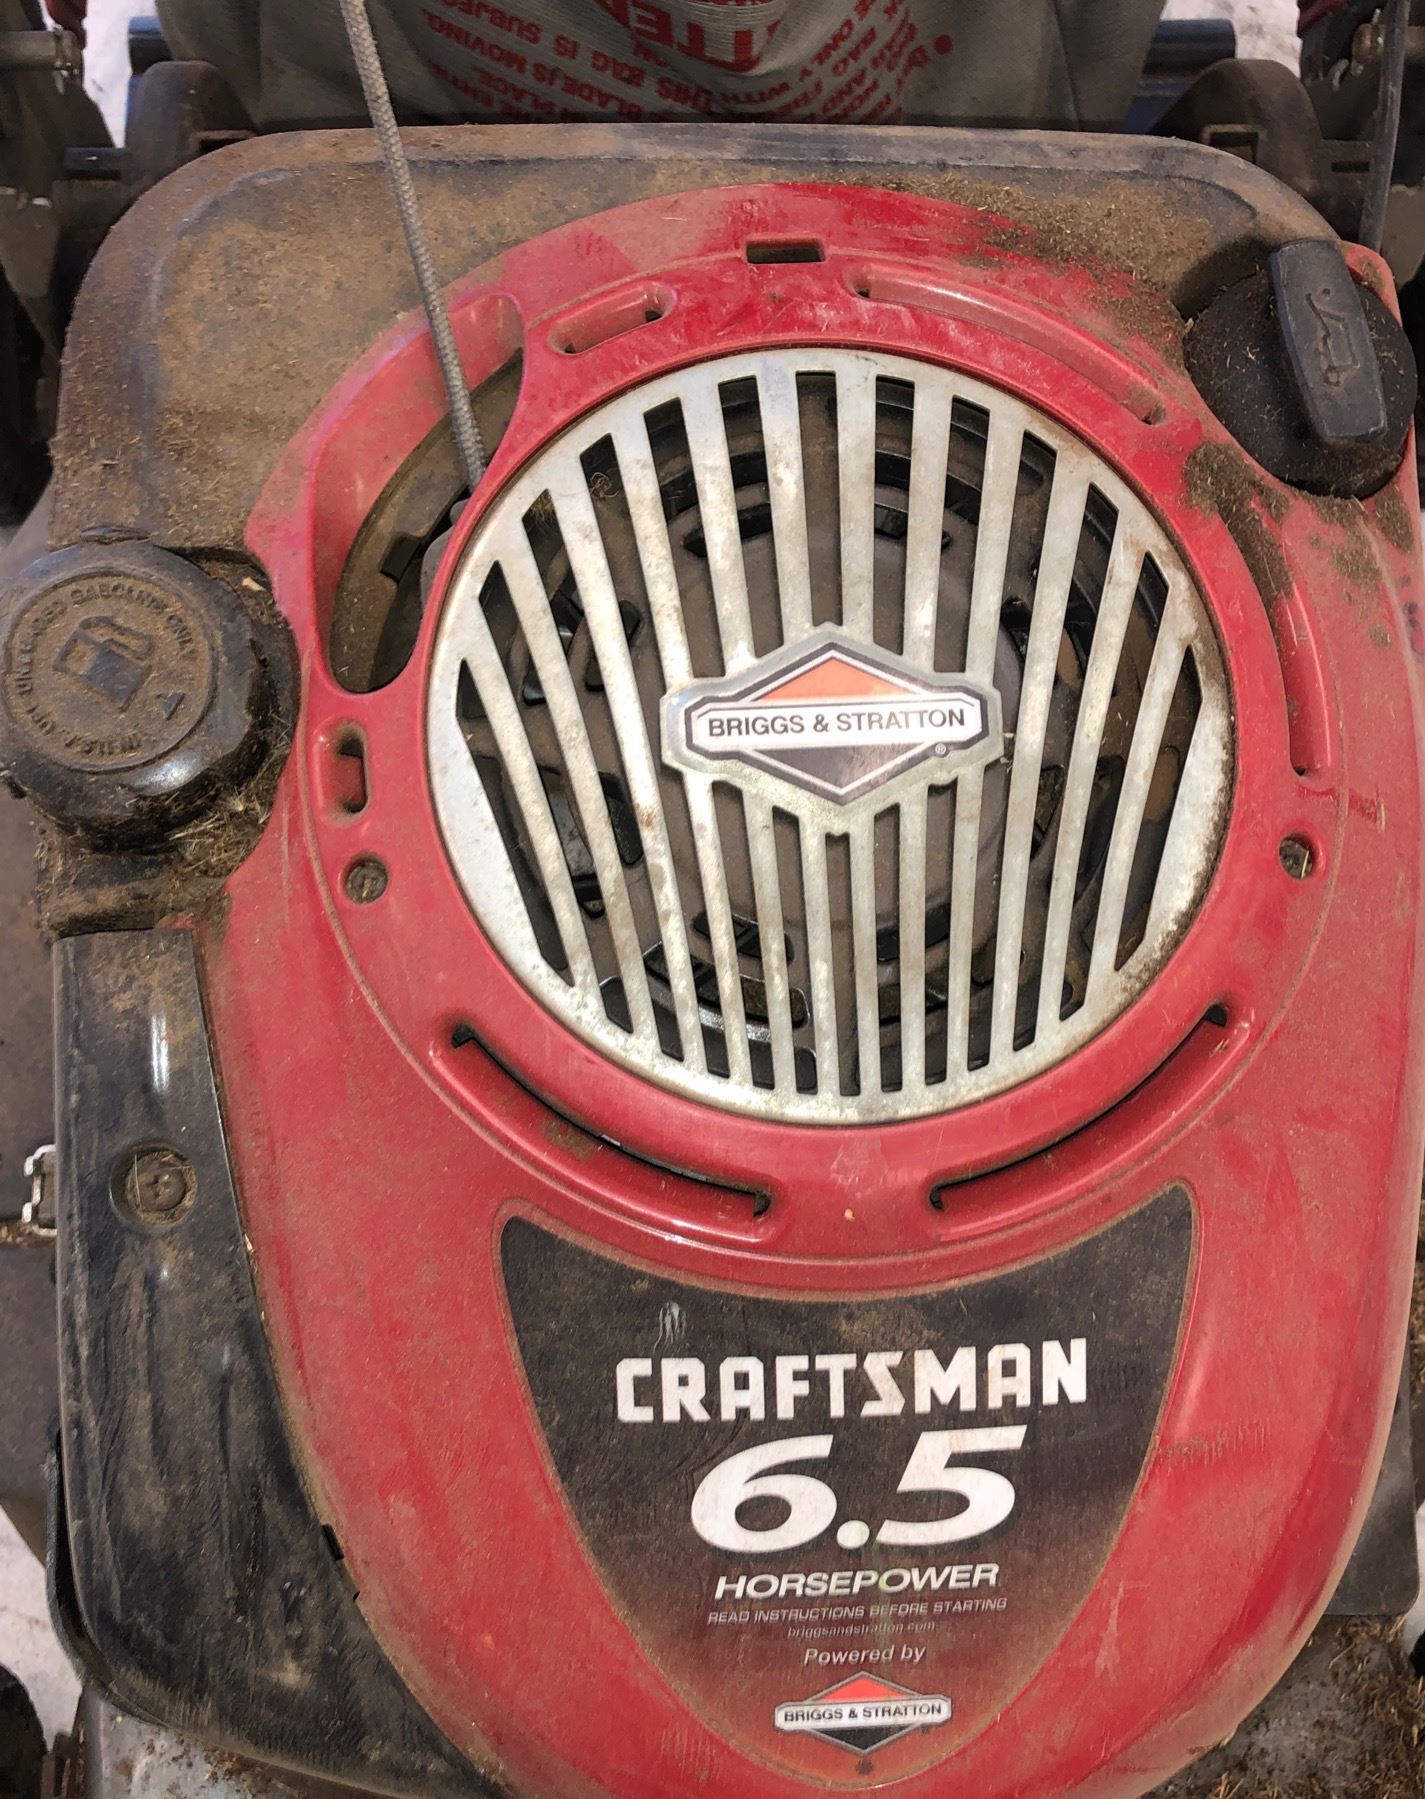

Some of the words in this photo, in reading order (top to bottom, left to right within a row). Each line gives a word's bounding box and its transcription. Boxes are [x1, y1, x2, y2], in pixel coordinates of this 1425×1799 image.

[553, 34, 580, 60] IS
[591, 51, 646, 89] BAG
[708, 714, 804, 737] BRIGGS
[813, 714, 829, 732] &
[836, 709, 965, 732] STRATTON
[615, 1337, 1087, 1423] CRAFTSMAN
[690, 1425, 1028, 1554] 6.5
[714, 1563, 1000, 1600] HORSEPOWER
[707, 1611, 749, 1625] READ
[754, 1605, 865, 1623] INSTRUCTIONS
[870, 1601, 929, 1617] BEFORE
[933, 1597, 1008, 1613] STARTING
[804, 1644, 895, 1666] Powered
[900, 1644, 926, 1664] by
[784, 1706, 843, 1722] BRIGGS
[848, 1708, 859, 1719] &
[862, 1704, 942, 1718] STRATTON
